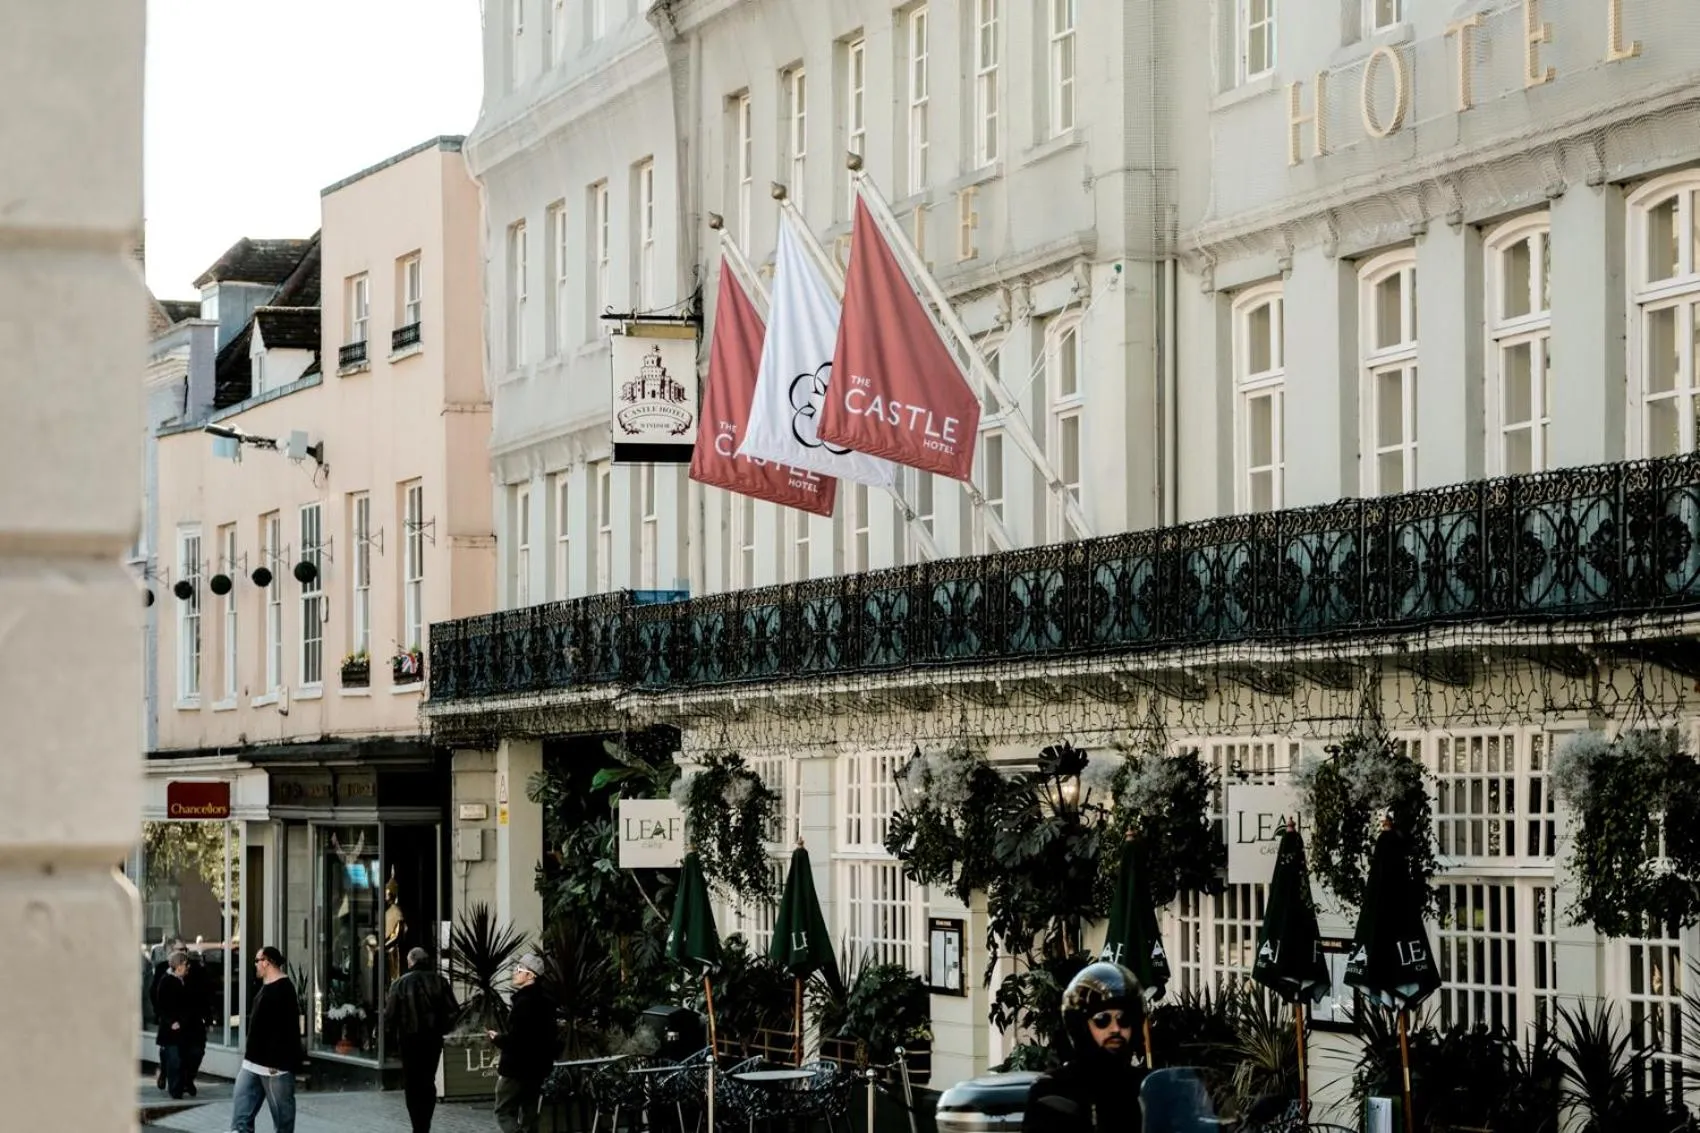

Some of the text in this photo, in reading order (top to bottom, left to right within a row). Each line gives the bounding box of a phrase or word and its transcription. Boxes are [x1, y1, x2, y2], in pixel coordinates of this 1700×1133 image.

[1286, 0, 1642, 167] HOTEL
[851, 375, 871, 387] THE
[844, 388, 960, 444] CASTLE
[719, 420, 737, 431] THE
[923, 440, 955, 455] HOTEL
[788, 478, 818, 493] HOTEL
[170, 801, 227, 815] Chancellors
[624, 817, 681, 841] LEAF
